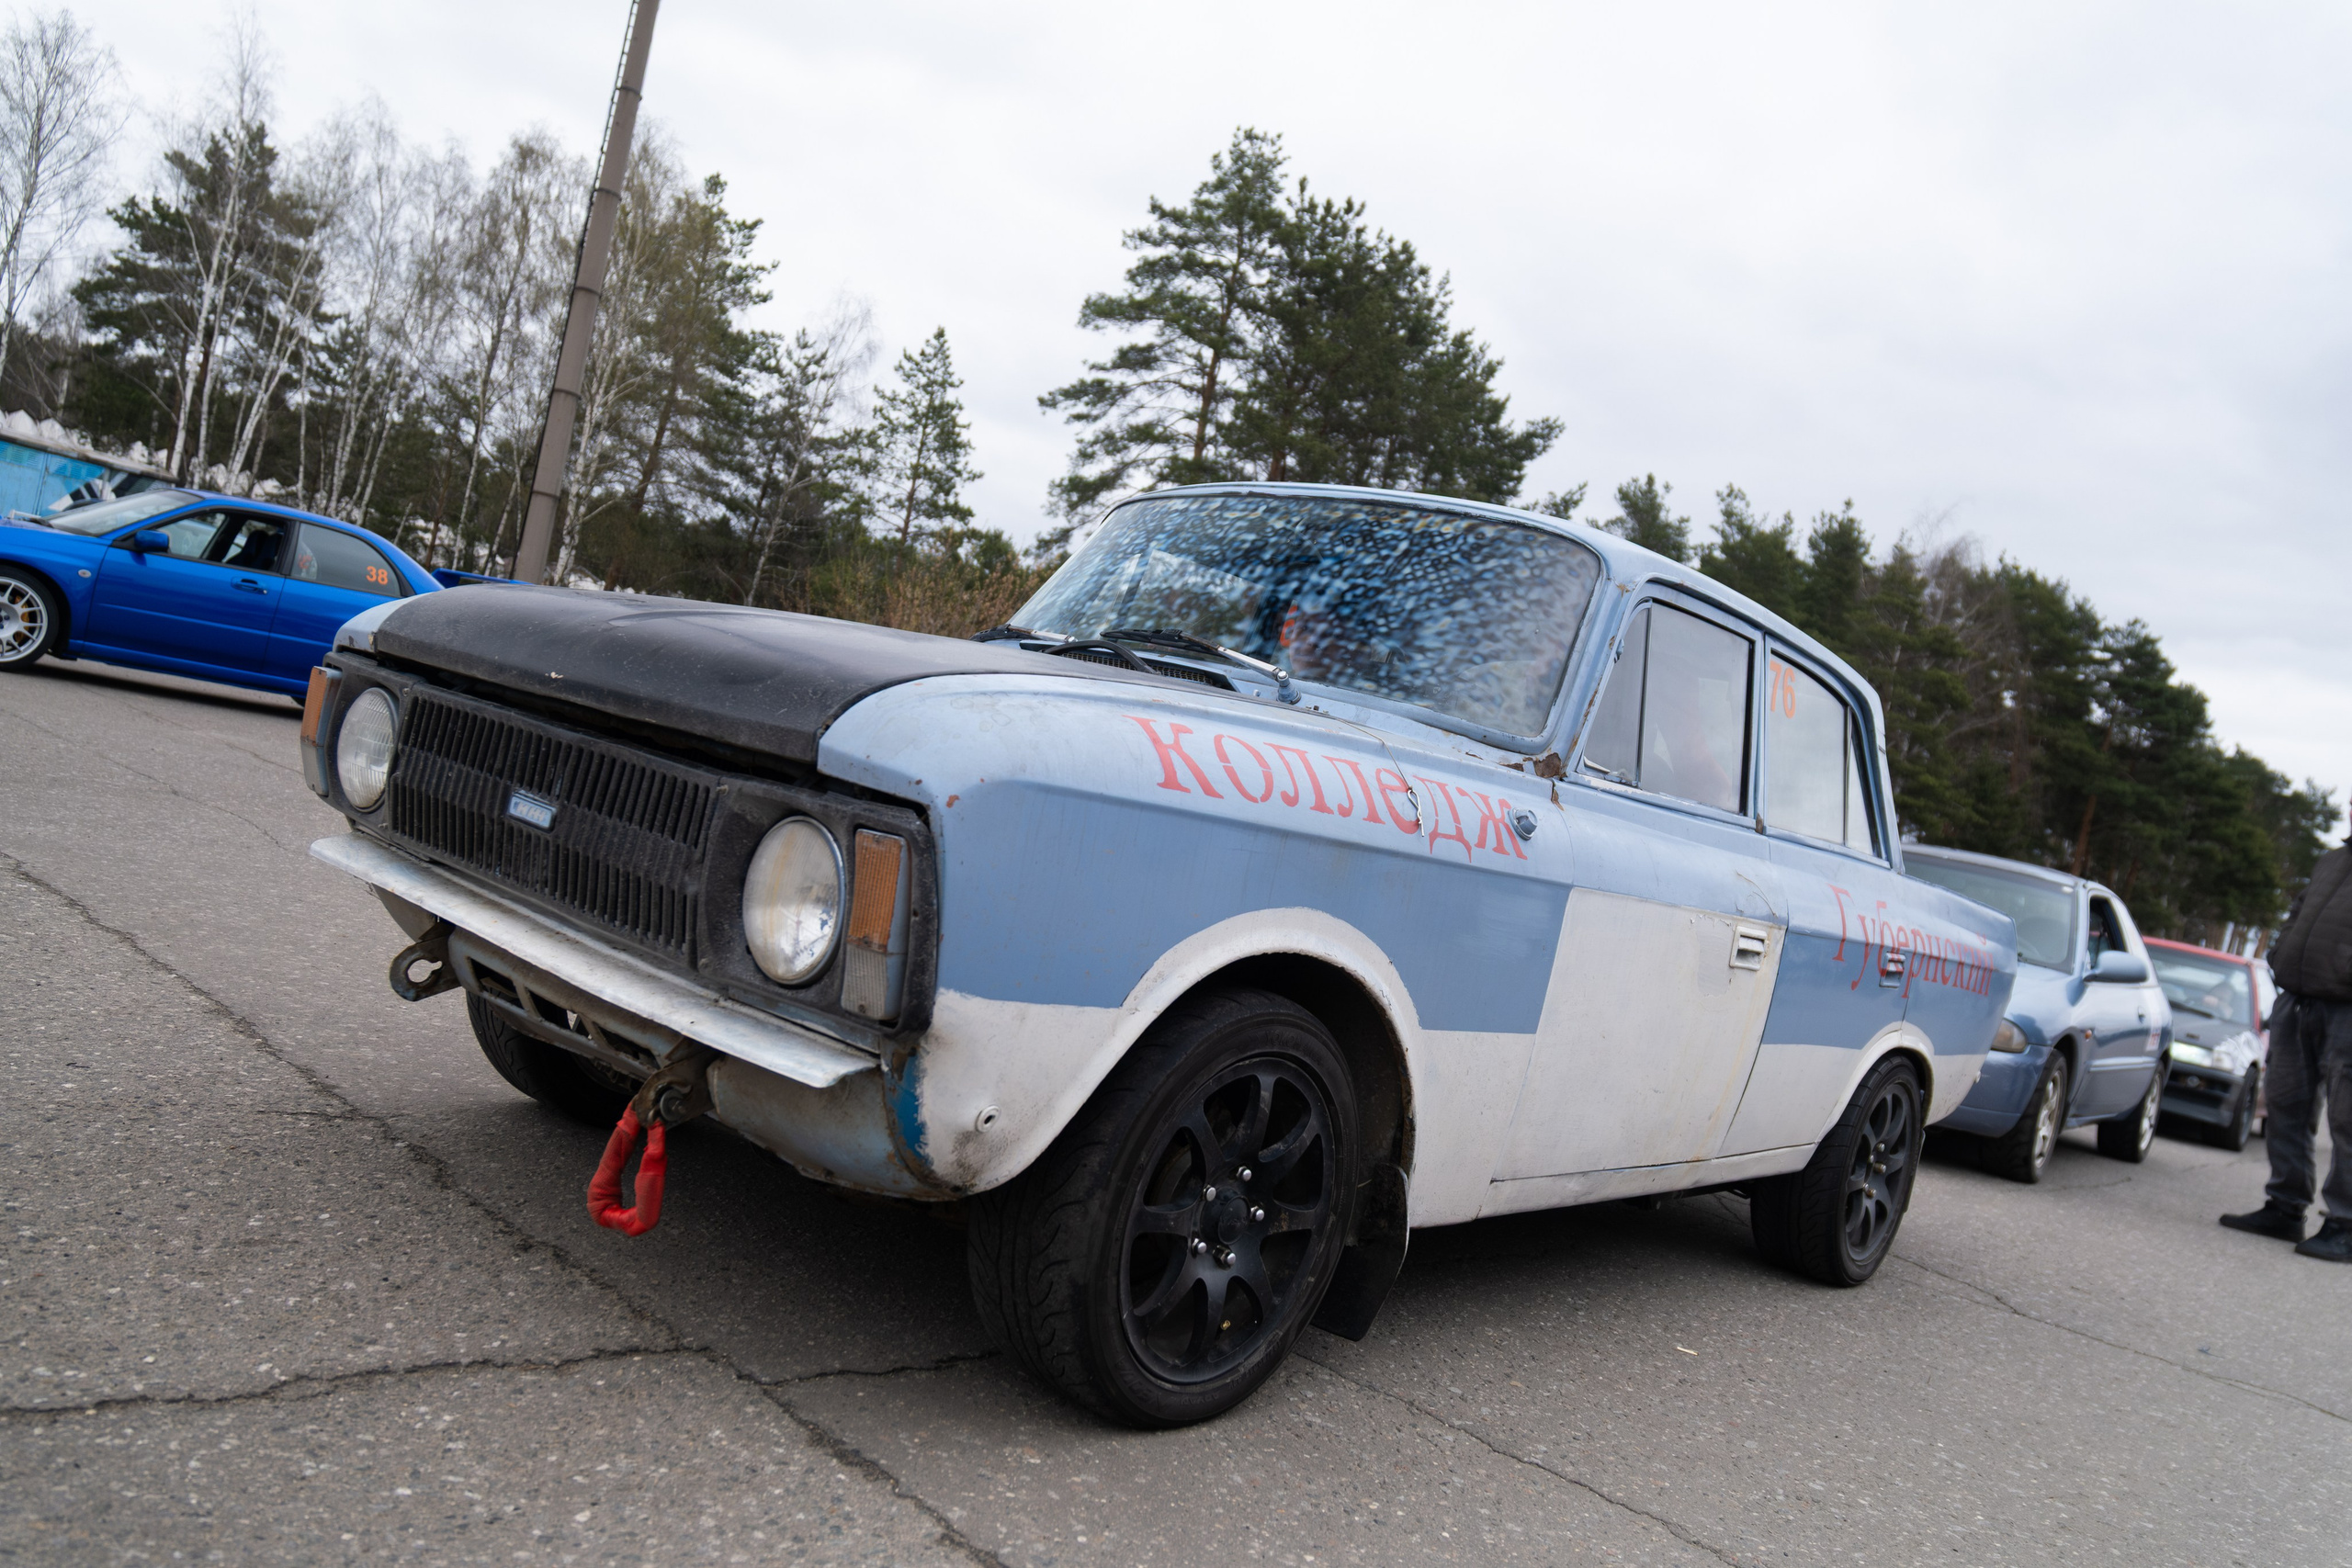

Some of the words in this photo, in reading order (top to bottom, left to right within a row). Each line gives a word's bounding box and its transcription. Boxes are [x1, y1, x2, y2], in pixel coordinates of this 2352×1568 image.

[366, 566, 388, 585] 38
[1770, 659, 1796, 719] 76
[1122, 715, 1528, 863] Колледж
[1826, 883, 1994, 998] Губернский
